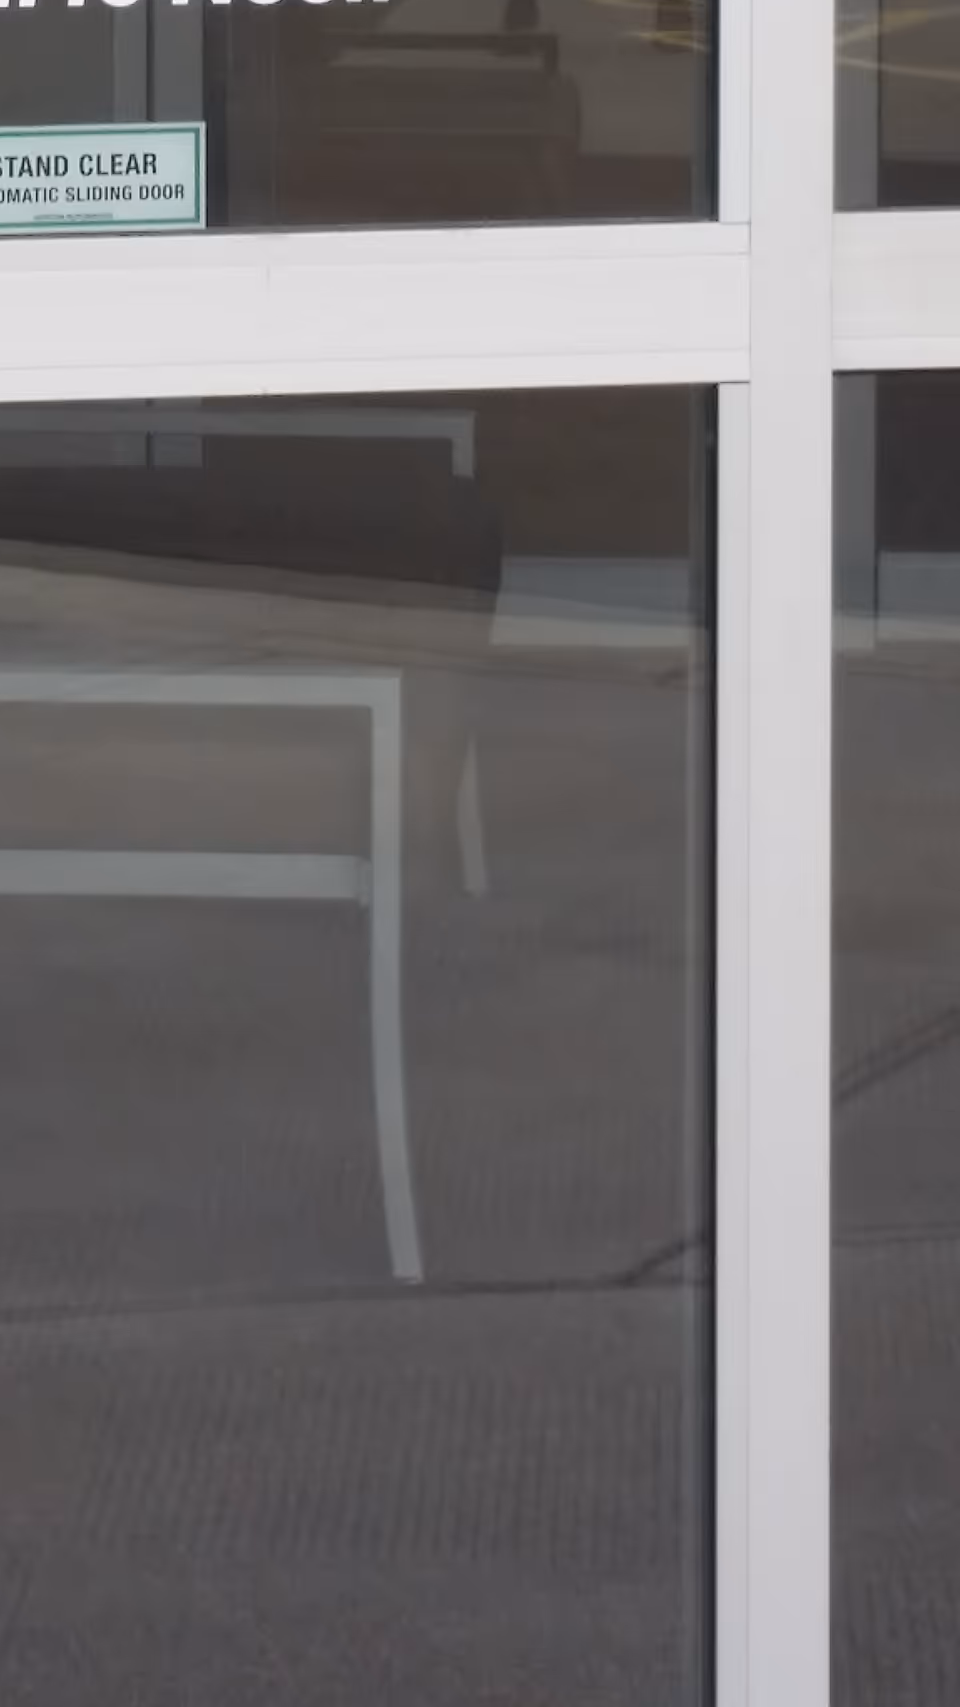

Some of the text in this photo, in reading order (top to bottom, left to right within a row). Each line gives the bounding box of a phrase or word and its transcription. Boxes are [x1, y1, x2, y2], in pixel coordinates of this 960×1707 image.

[79, 152, 158, 177] CLEAR
[65, 184, 133, 203] SLIDING
[139, 183, 185, 201] DOOR
